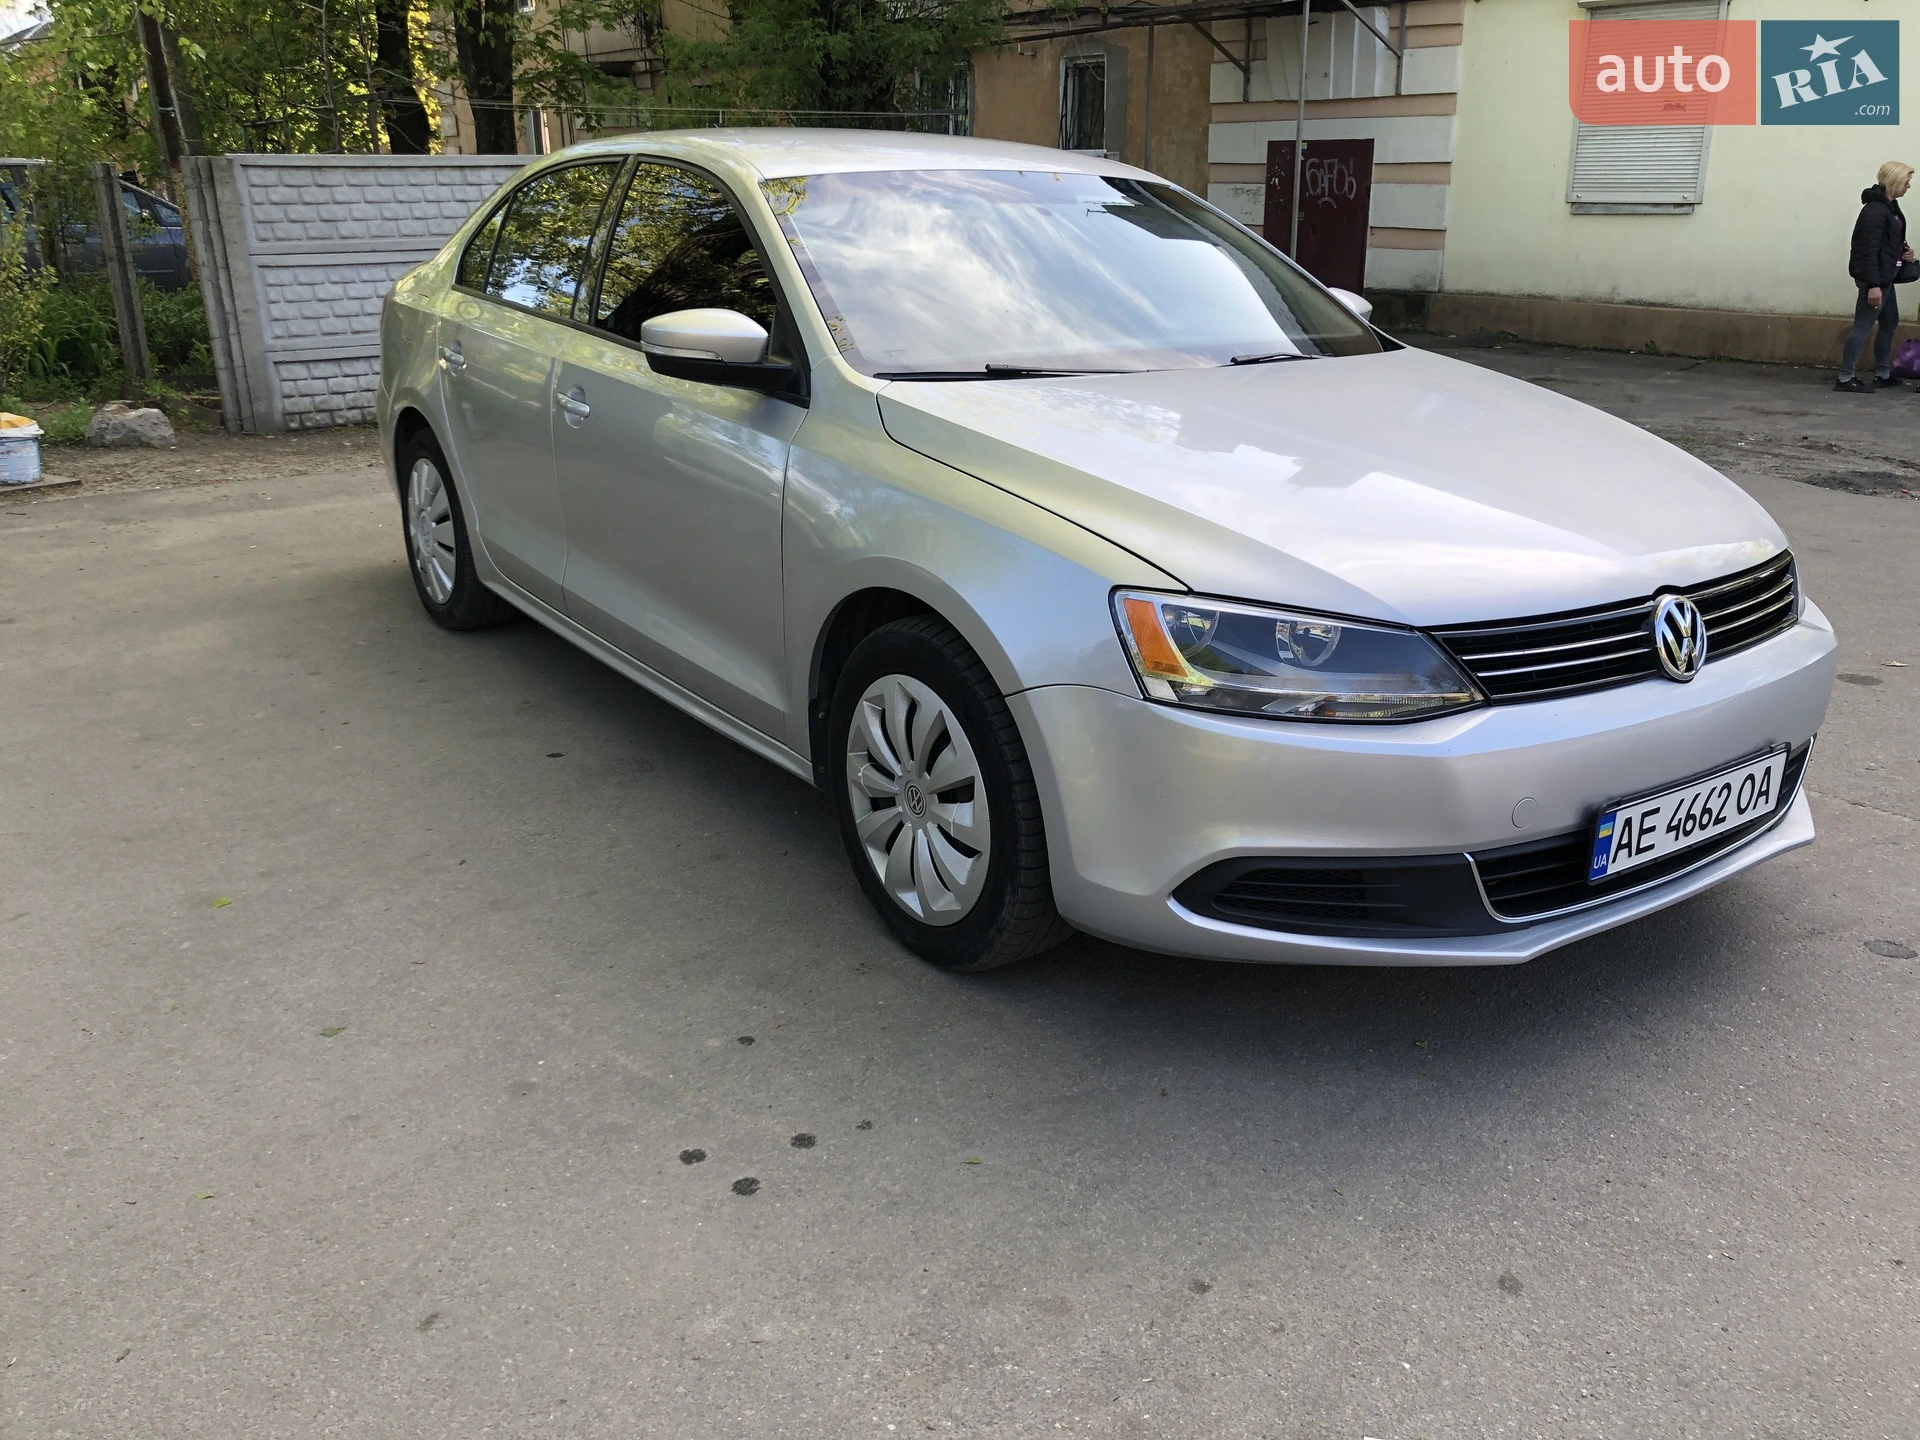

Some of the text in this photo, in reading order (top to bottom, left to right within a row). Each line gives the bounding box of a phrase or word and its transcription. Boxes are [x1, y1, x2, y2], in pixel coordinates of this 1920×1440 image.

[1611, 765, 1772, 864] AE 4662 OA
[1593, 853, 1608, 870] UA
